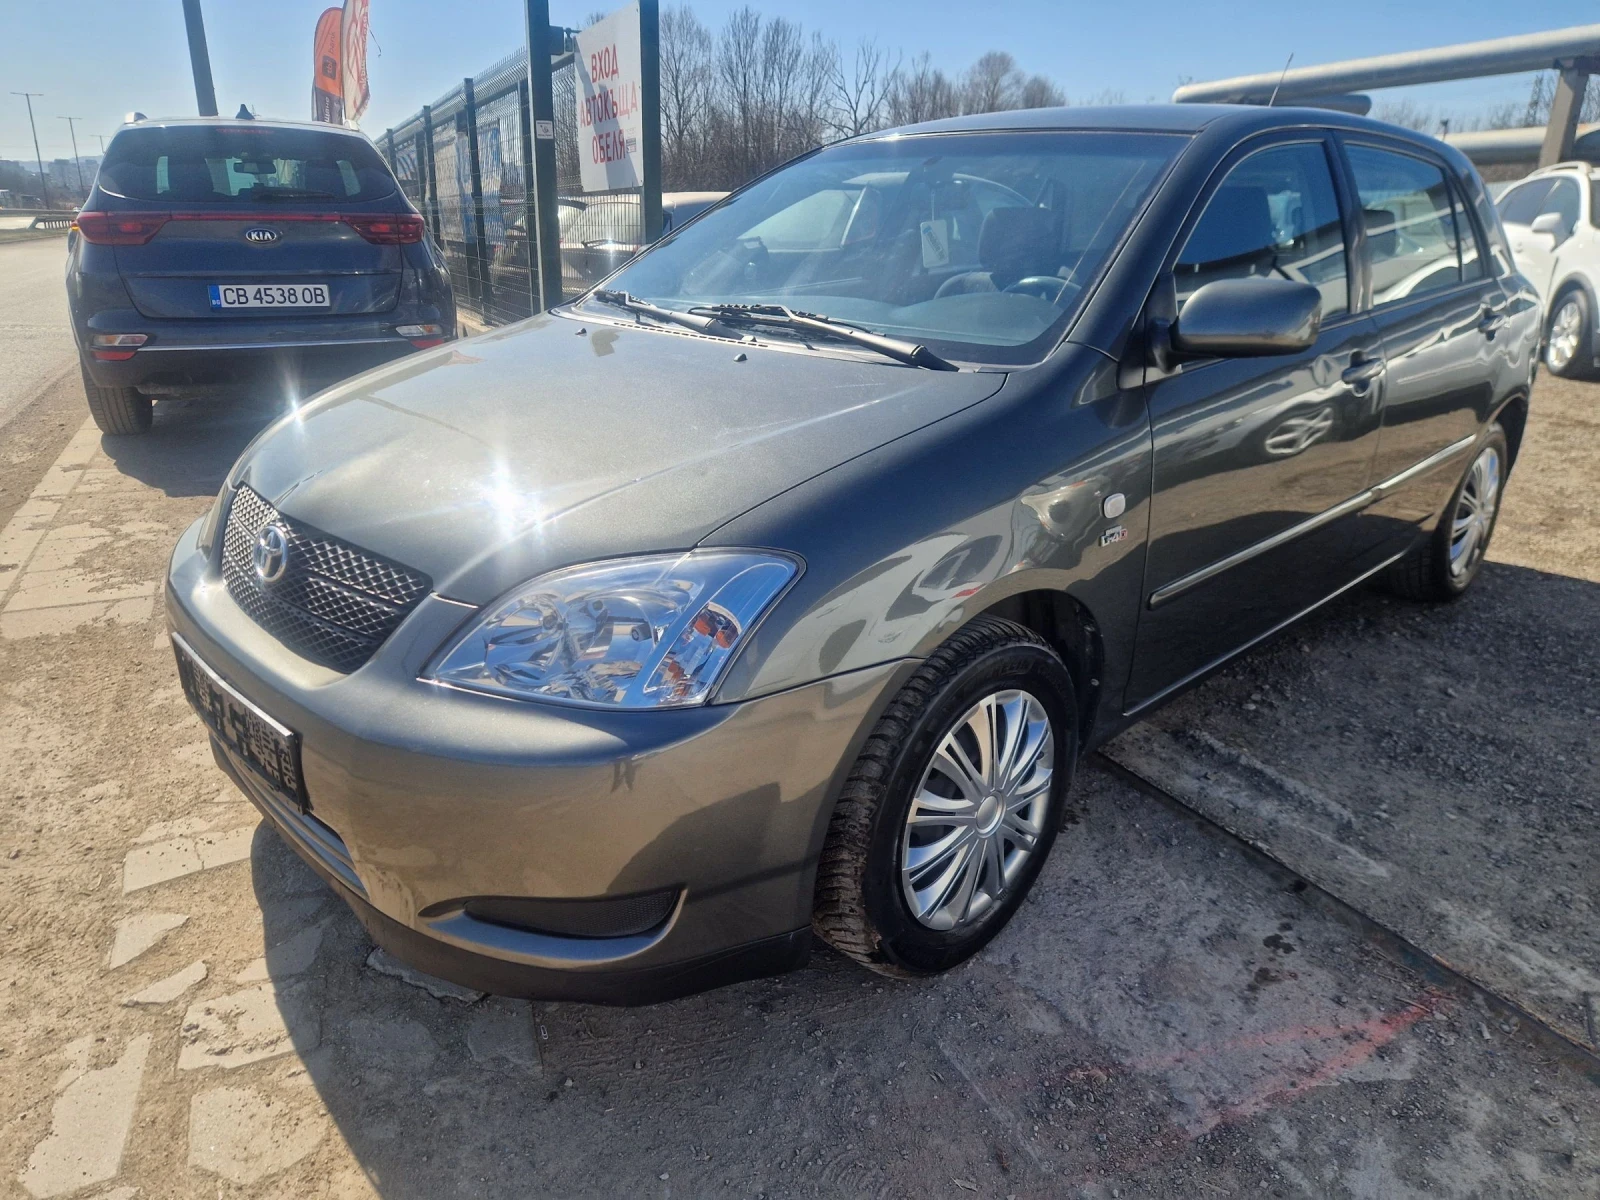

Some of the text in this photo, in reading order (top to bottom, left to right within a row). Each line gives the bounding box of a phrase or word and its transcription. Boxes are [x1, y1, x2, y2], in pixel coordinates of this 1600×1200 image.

[591, 43, 619, 83] ВХОД
[580, 81, 638, 128] АВТОКЪЩА
[592, 129, 626, 164] ОБЕЛЯ
[251, 231, 272, 240] KIA
[223, 288, 249, 305] CB
[253, 288, 298, 304] 4538
